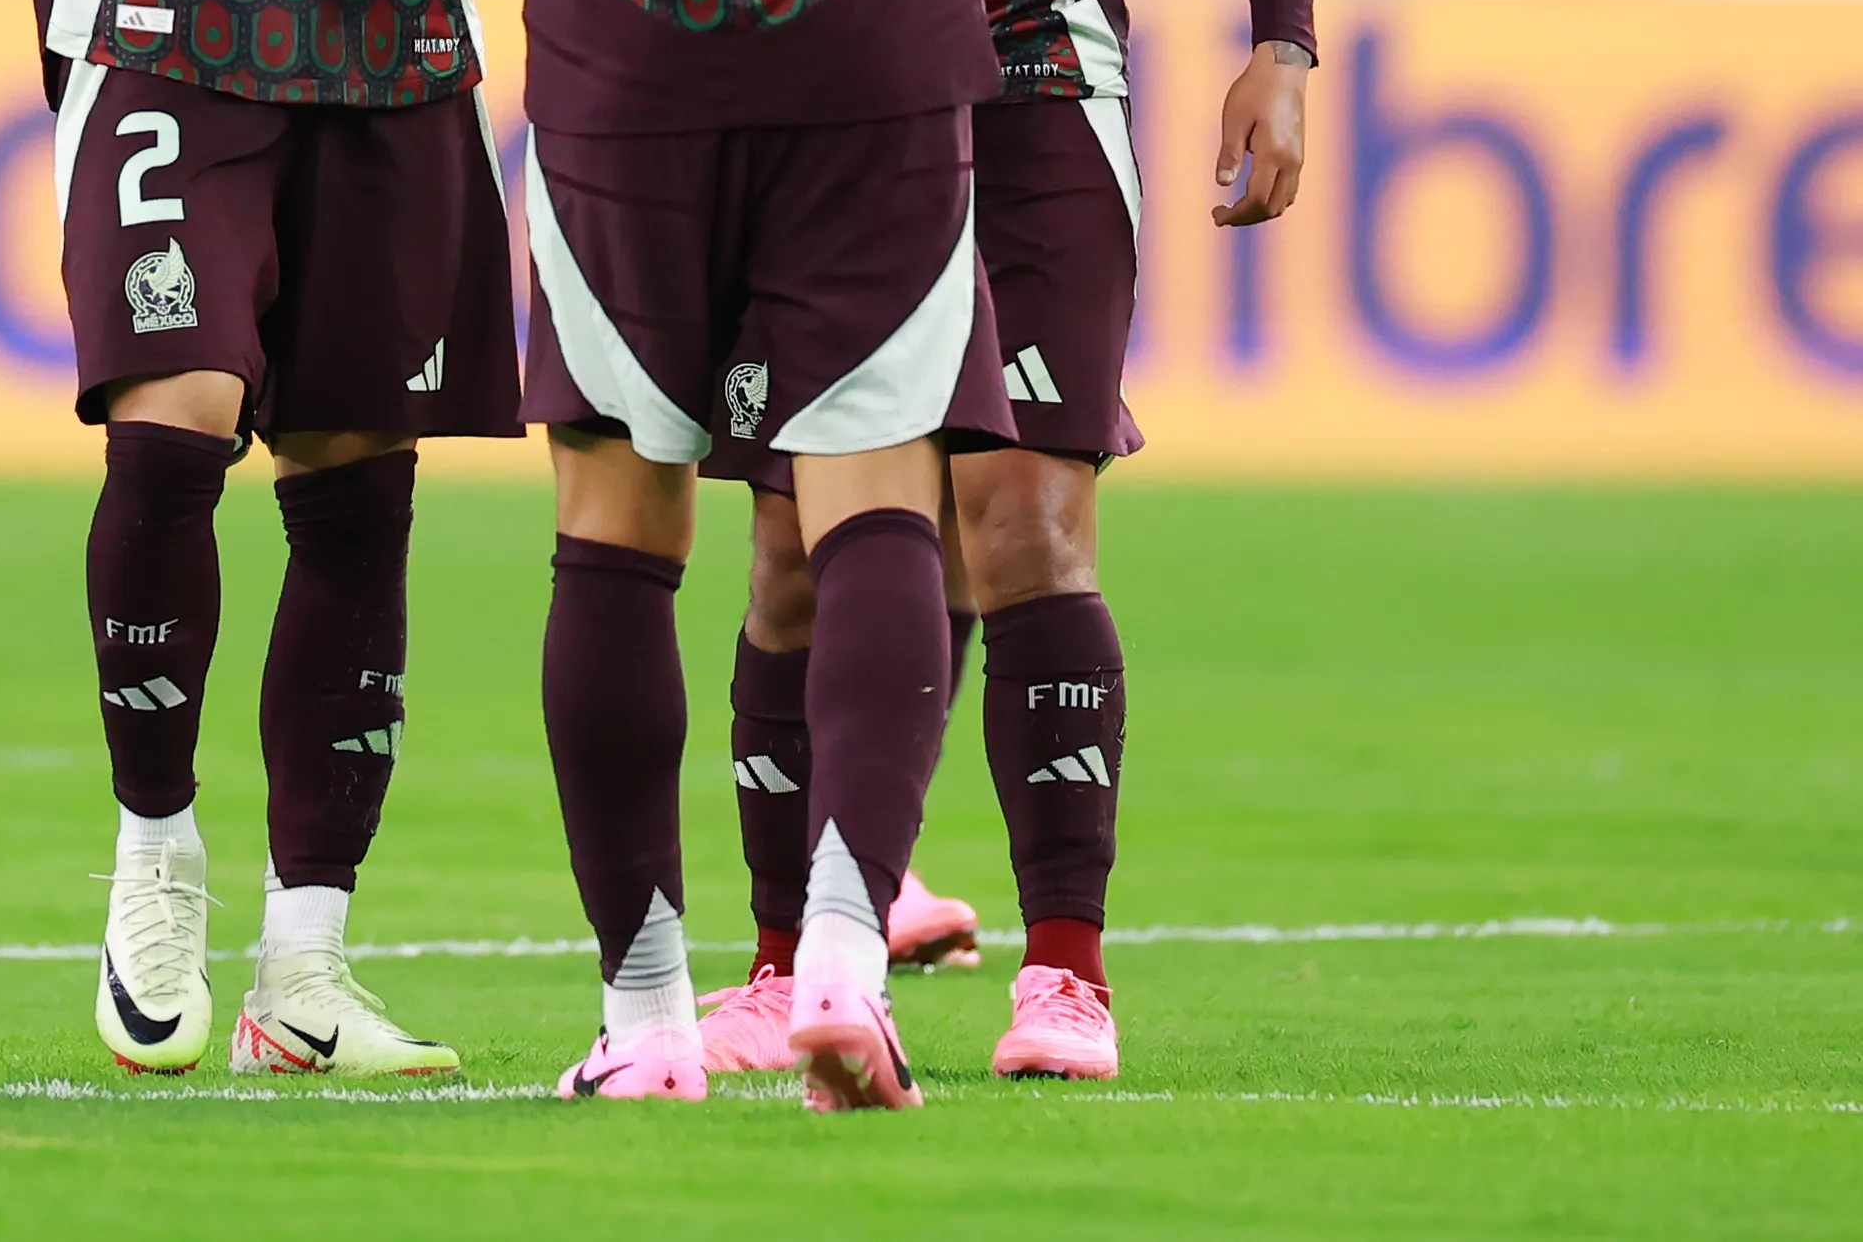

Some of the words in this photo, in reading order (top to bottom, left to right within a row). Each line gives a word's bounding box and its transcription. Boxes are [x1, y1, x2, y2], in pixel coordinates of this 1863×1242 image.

[115, 110, 184, 227] 2
[137, 313, 194, 329] MÉXICO
[106, 618, 179, 644] FMF
[359, 669, 404, 697] FM
[1028, 682, 1109, 709] FMF
